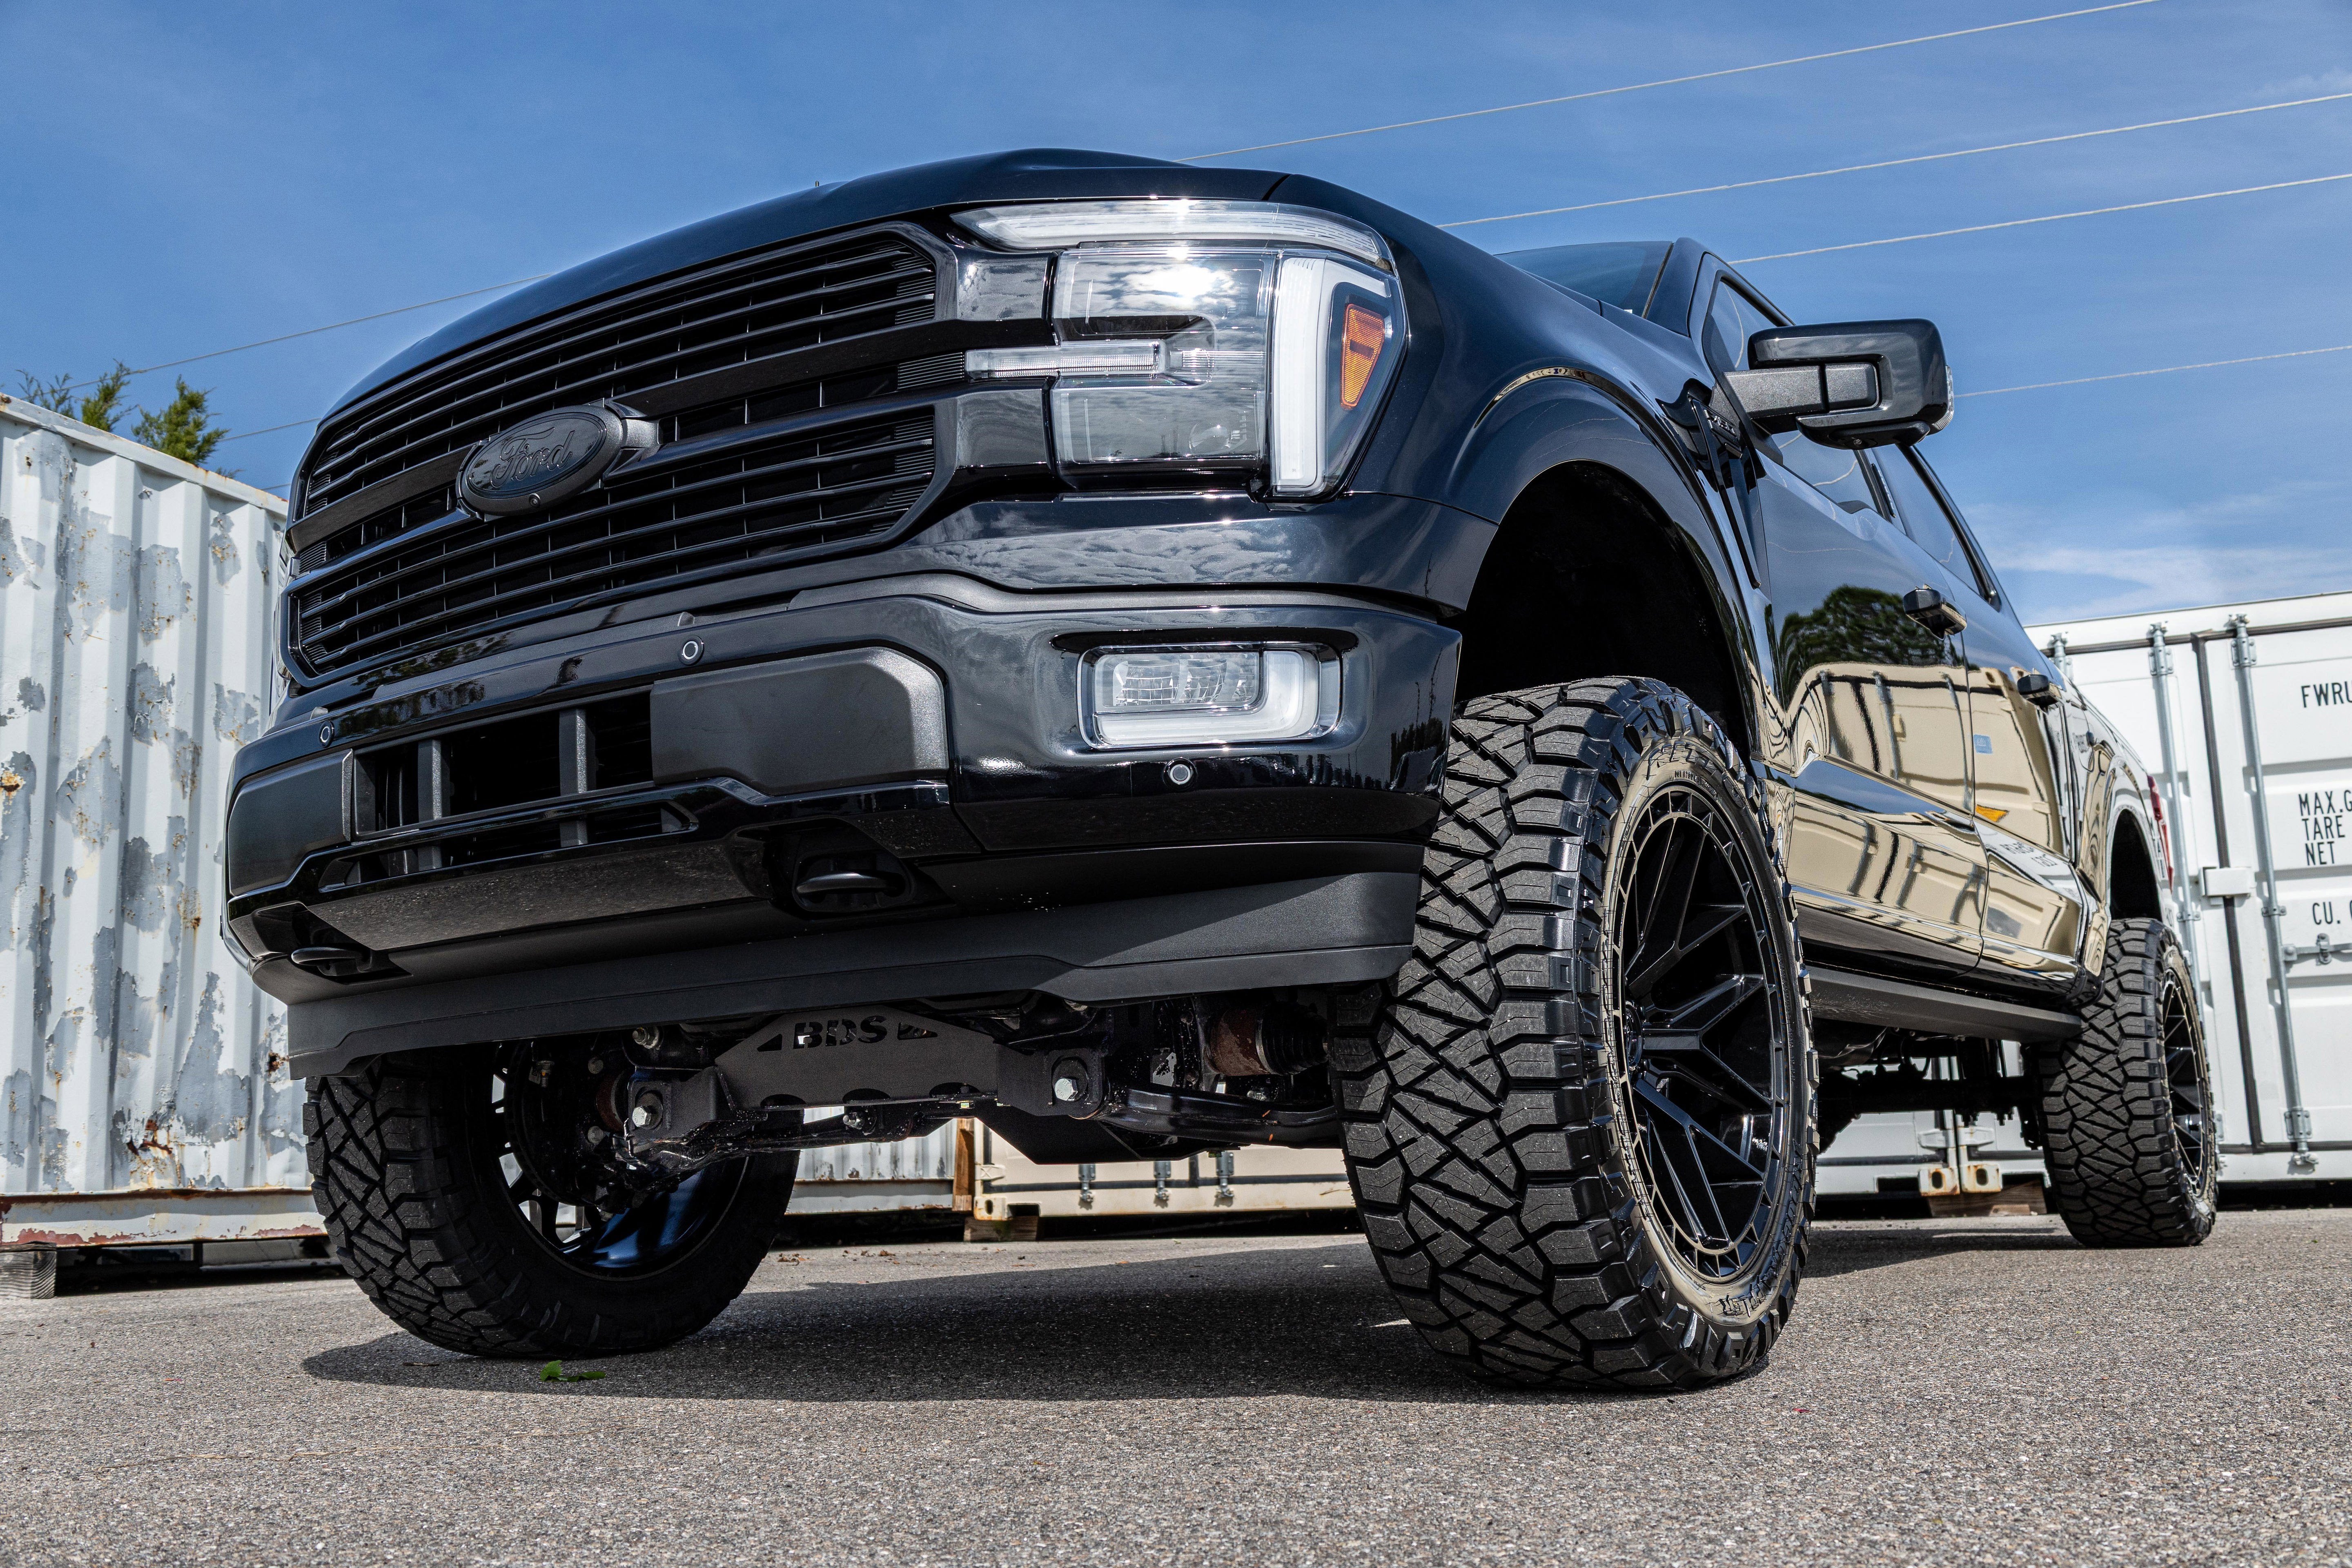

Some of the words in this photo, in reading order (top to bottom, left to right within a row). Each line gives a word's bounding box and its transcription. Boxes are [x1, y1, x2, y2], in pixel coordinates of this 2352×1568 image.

[491, 427, 575, 488] Ford
[2301, 681, 2352, 708] FWRU
[2302, 815, 2345, 840] TARE
[2305, 841, 2334, 865] NET
[2312, 901, 2340, 925] CU.
[793, 1015, 887, 1049] BDS
